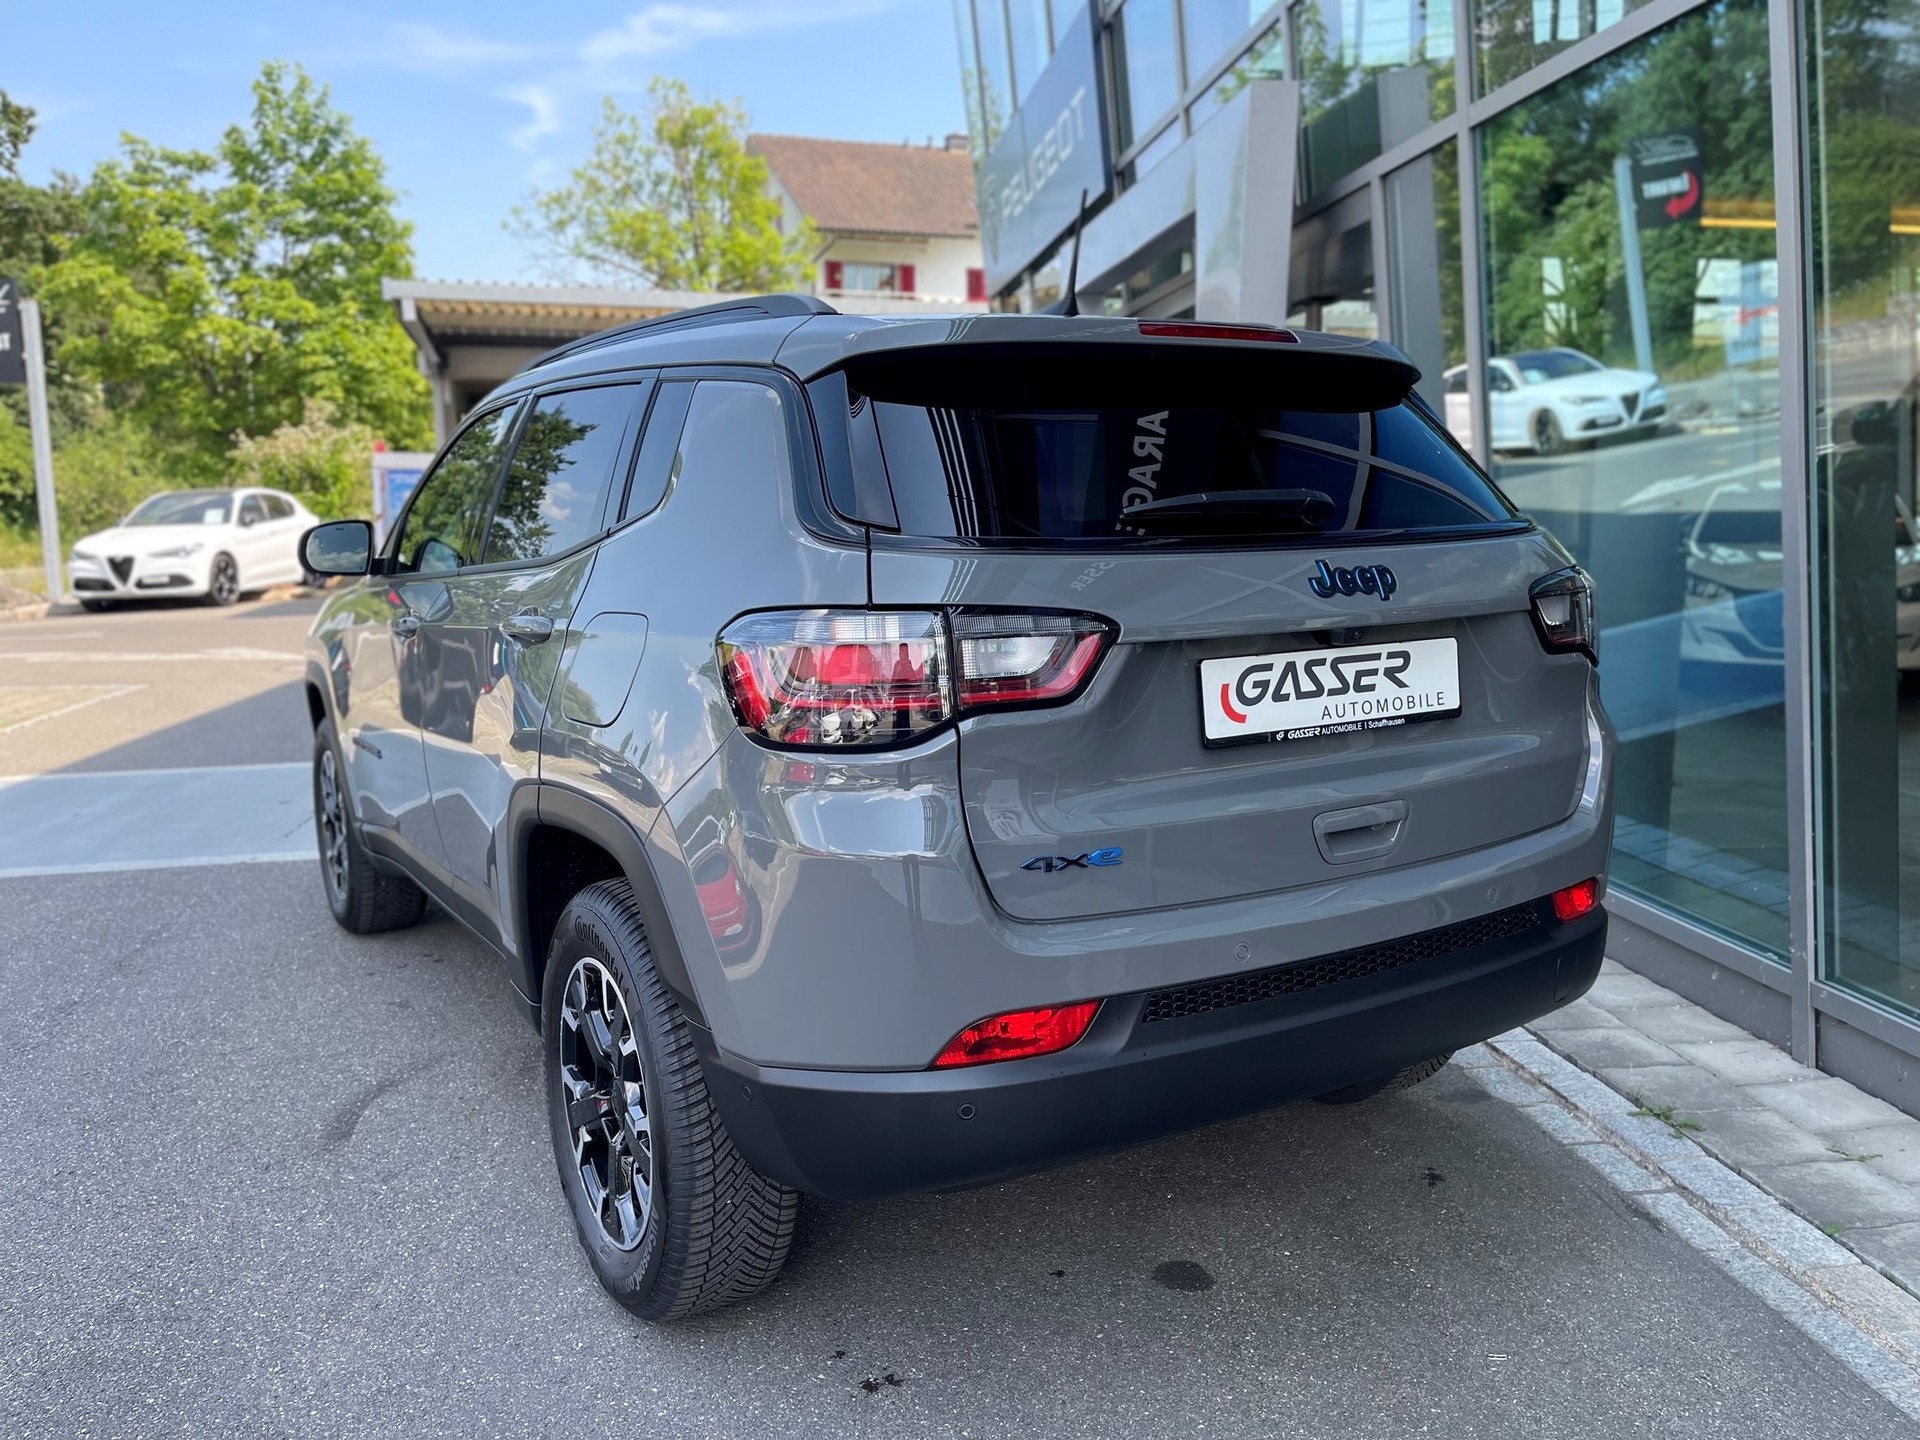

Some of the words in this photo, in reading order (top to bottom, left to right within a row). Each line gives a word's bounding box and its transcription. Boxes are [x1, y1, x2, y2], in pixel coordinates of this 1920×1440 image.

[1001, 85, 1086, 229] PEUGEOT
[1307, 559, 1397, 601] Jeep
[1235, 650, 1411, 707] GASSER
[1321, 691, 1446, 721] AUTOMOBILE
[1287, 727, 1321, 740] GASSER
[1321, 722, 1363, 736] AUTOMOBILE
[1368, 717, 1406, 729] Schaffhausen
